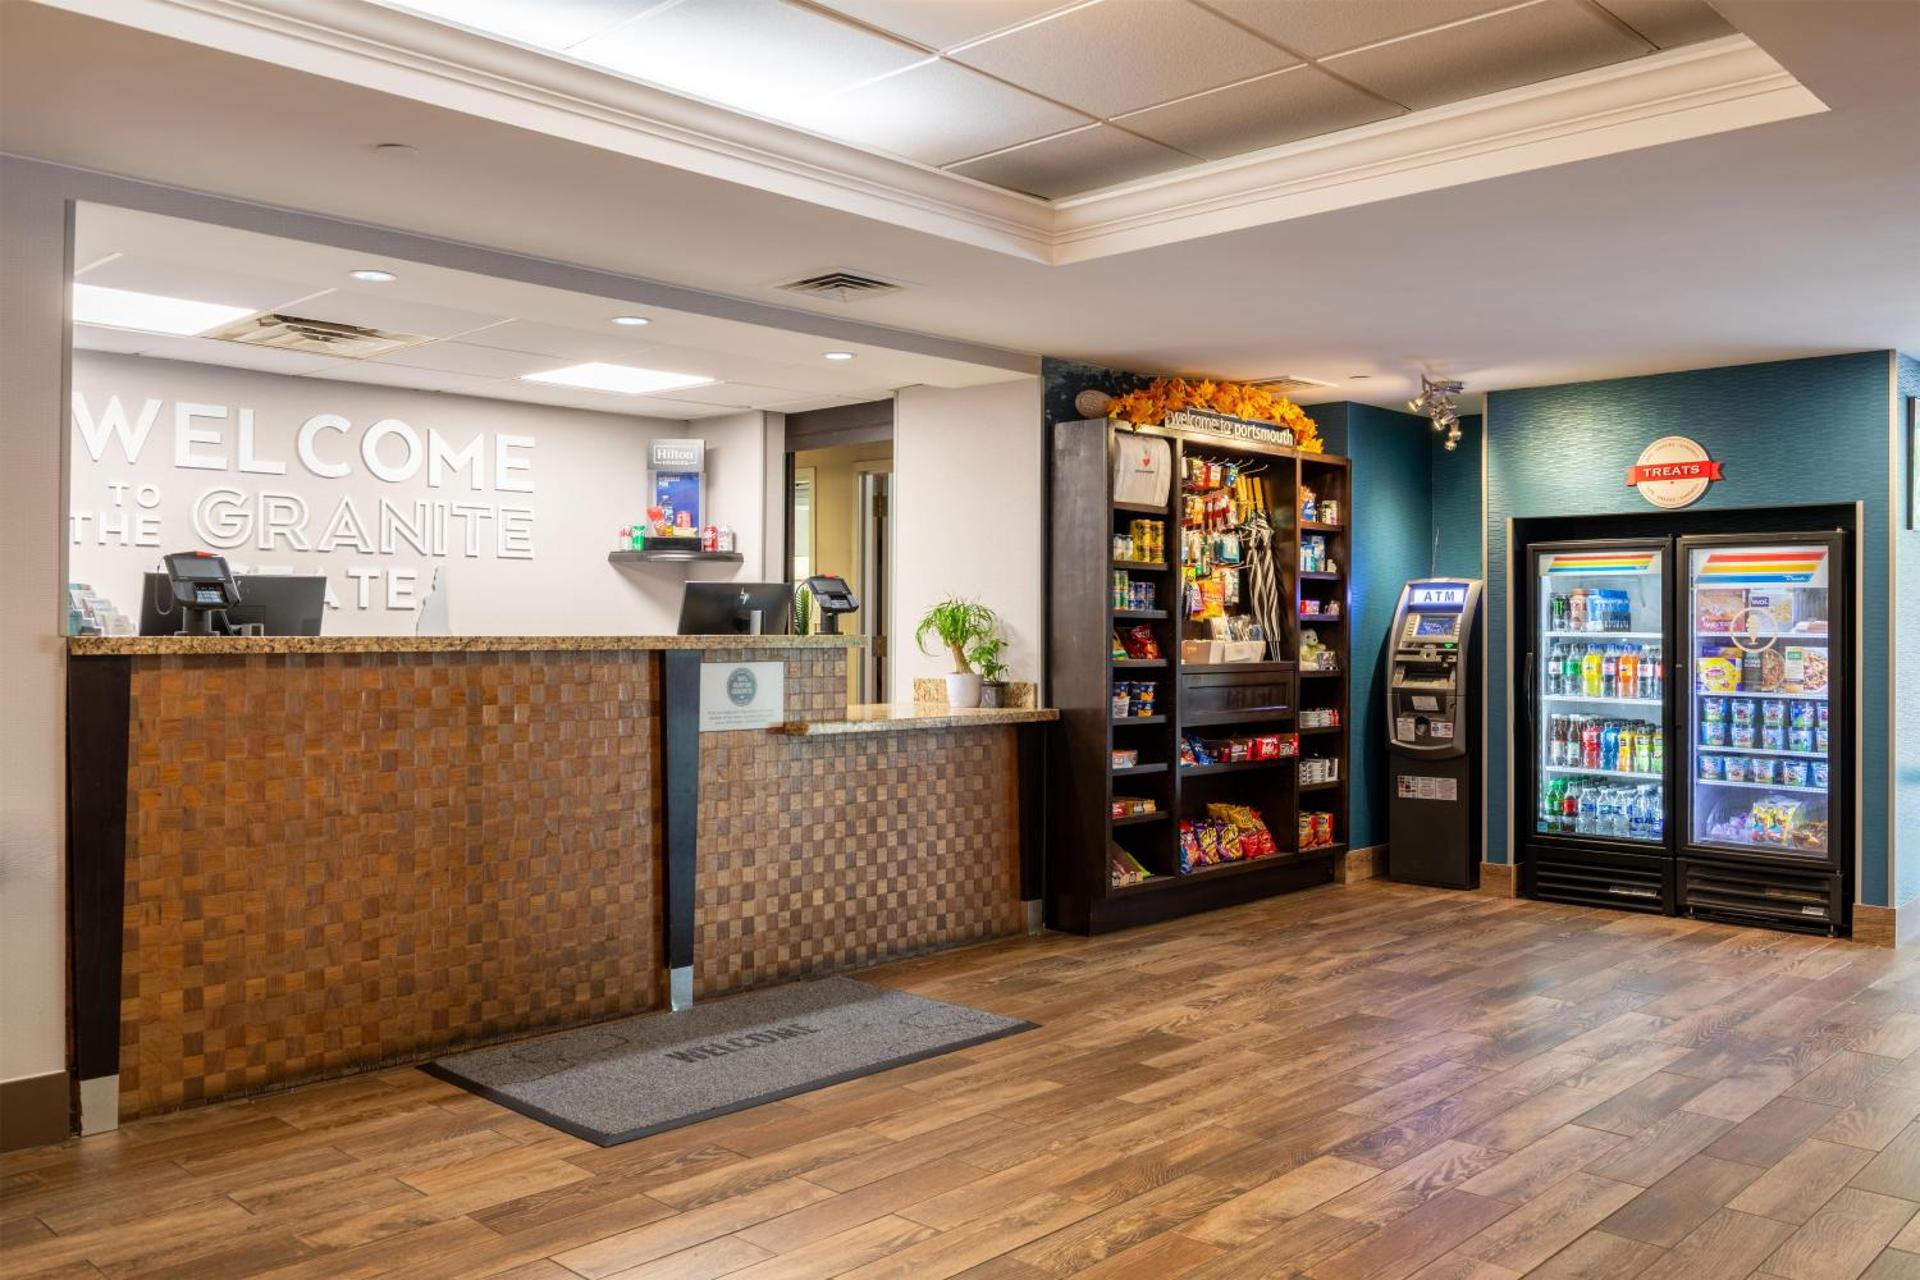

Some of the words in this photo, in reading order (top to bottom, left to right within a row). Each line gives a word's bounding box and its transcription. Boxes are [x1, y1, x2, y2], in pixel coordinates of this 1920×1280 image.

[71, 391, 536, 493] WELCOME
[1172, 408, 1218, 432] welcome
[1219, 419, 1232, 435] to
[1234, 423, 1294, 446] portsmouth
[656, 448, 694, 460] Hilton
[1643, 465, 1700, 477] TREATS
[108, 481, 161, 509] TO
[70, 511, 161, 547] THE
[191, 487, 536, 559] GRANITE
[1424, 591, 1455, 602] ATM
[664, 1023, 821, 1063] WELCOME
